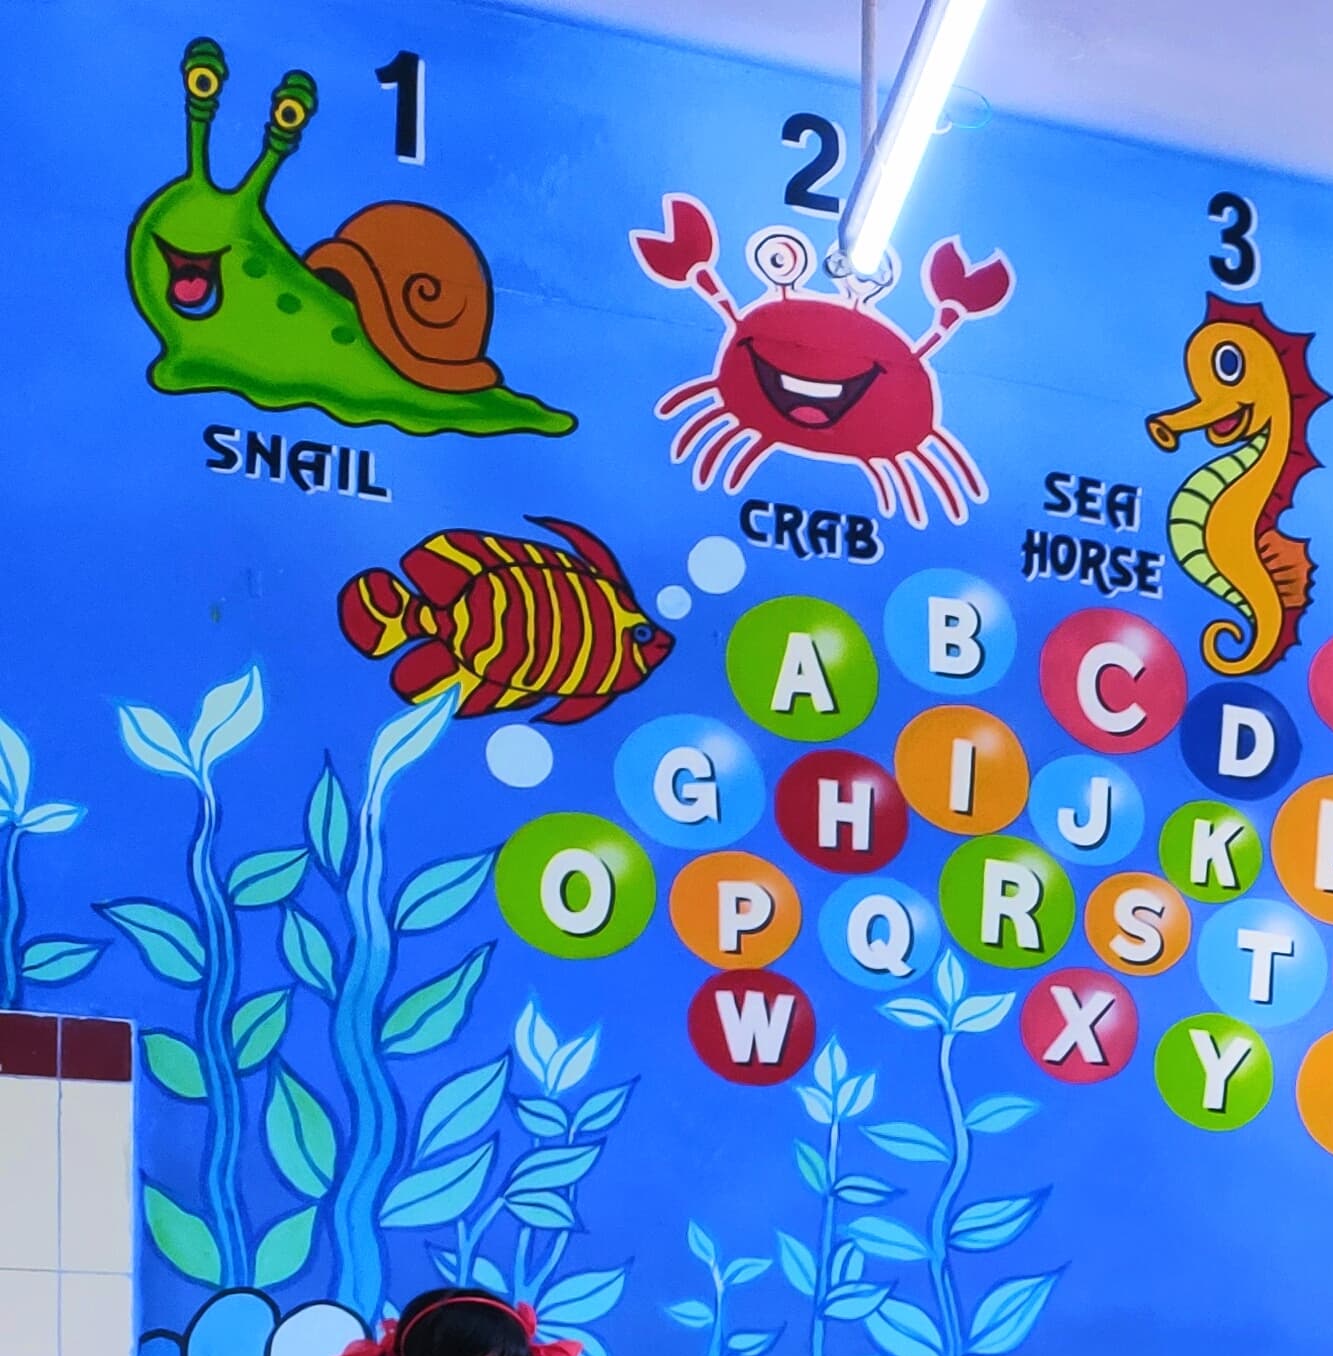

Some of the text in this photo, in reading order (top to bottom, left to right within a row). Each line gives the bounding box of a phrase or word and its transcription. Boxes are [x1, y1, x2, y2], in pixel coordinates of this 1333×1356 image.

[374, 51, 426, 165] 1
[781, 113, 842, 214] 2
[1208, 191, 1259, 289] 3
[203, 422, 393, 503] SNAIL
[1042, 471, 1142, 532] SEA
[738, 498, 883, 564] CRAB
[1021, 532, 1167, 598] HORSE
[770, 631, 839, 714] A
[927, 596, 982, 677] B
[1076, 642, 1147, 736] C
[1218, 704, 1277, 779] D
[652, 746, 720, 825] G
[816, 778, 874, 852] H
[949, 739, 975, 814] I
[1056, 777, 1111, 849] J
[1190, 818, 1246, 889] K
[539, 848, 615, 936] O
[716, 880, 774, 955] P
[846, 895, 912, 977] Q
[980, 858, 1044, 952] R
[1108, 888, 1165, 965] S
[1237, 929, 1294, 1005] T
[714, 990, 796, 1066] W
[1043, 986, 1115, 1065] X
[1188, 1028, 1252, 1111] Y
